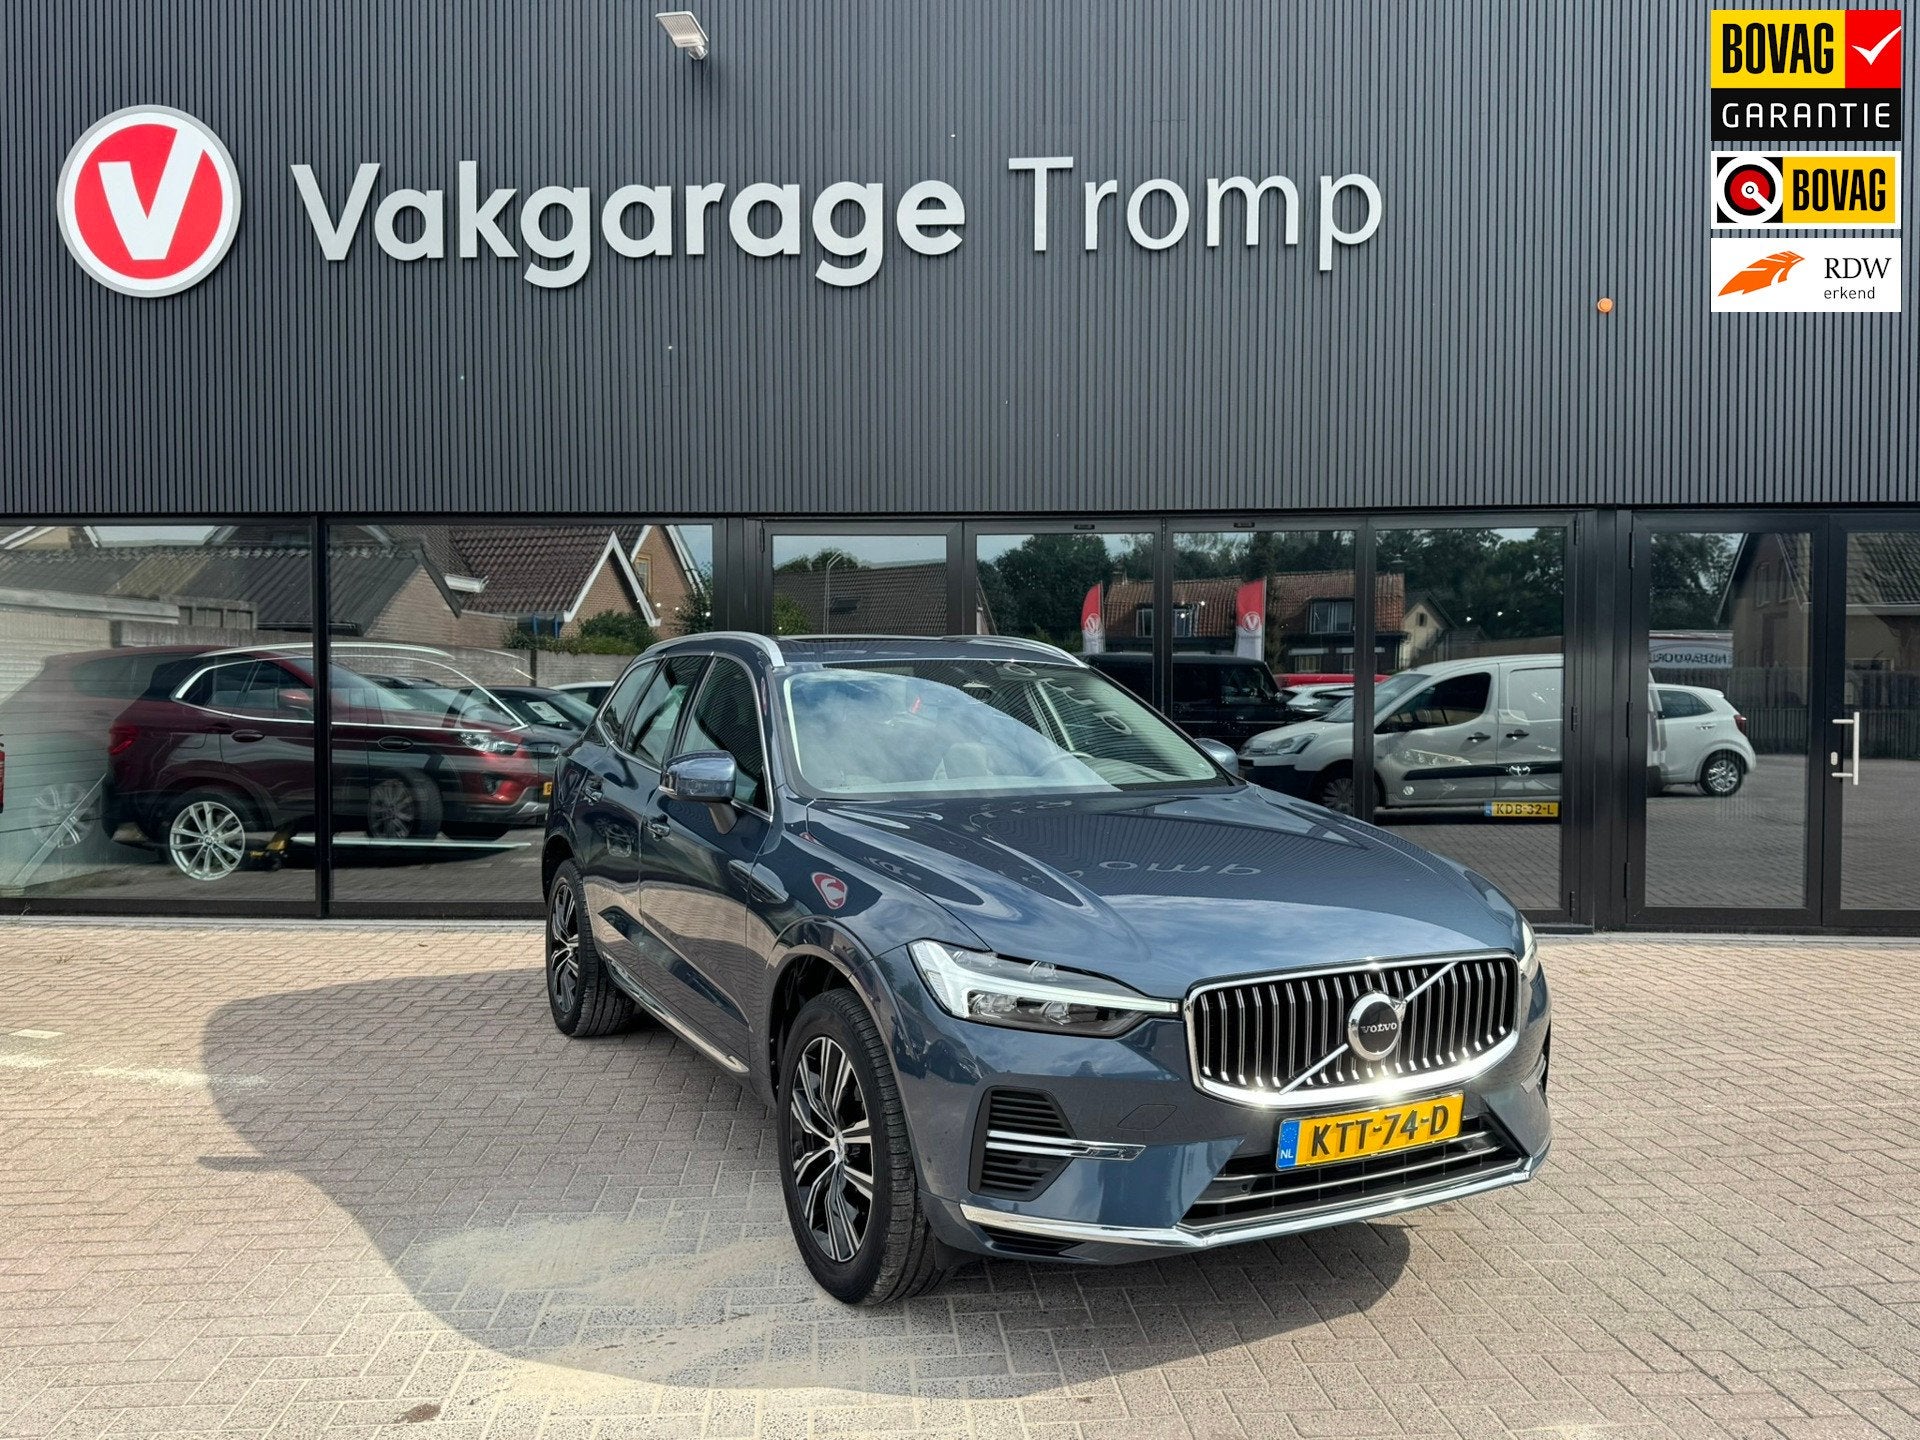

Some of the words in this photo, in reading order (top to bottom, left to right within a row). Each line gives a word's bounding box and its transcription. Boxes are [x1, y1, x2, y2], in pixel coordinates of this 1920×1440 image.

[290, 160, 965, 289] Vakgarage
[1008, 156, 1383, 272] Tromp
[1496, 803, 1555, 815] KDB-32-L
[1360, 1022, 1398, 1034] VOLVO
[1311, 1105, 1450, 1157] KTT-74-D
[1280, 1149, 1294, 1160] NL
